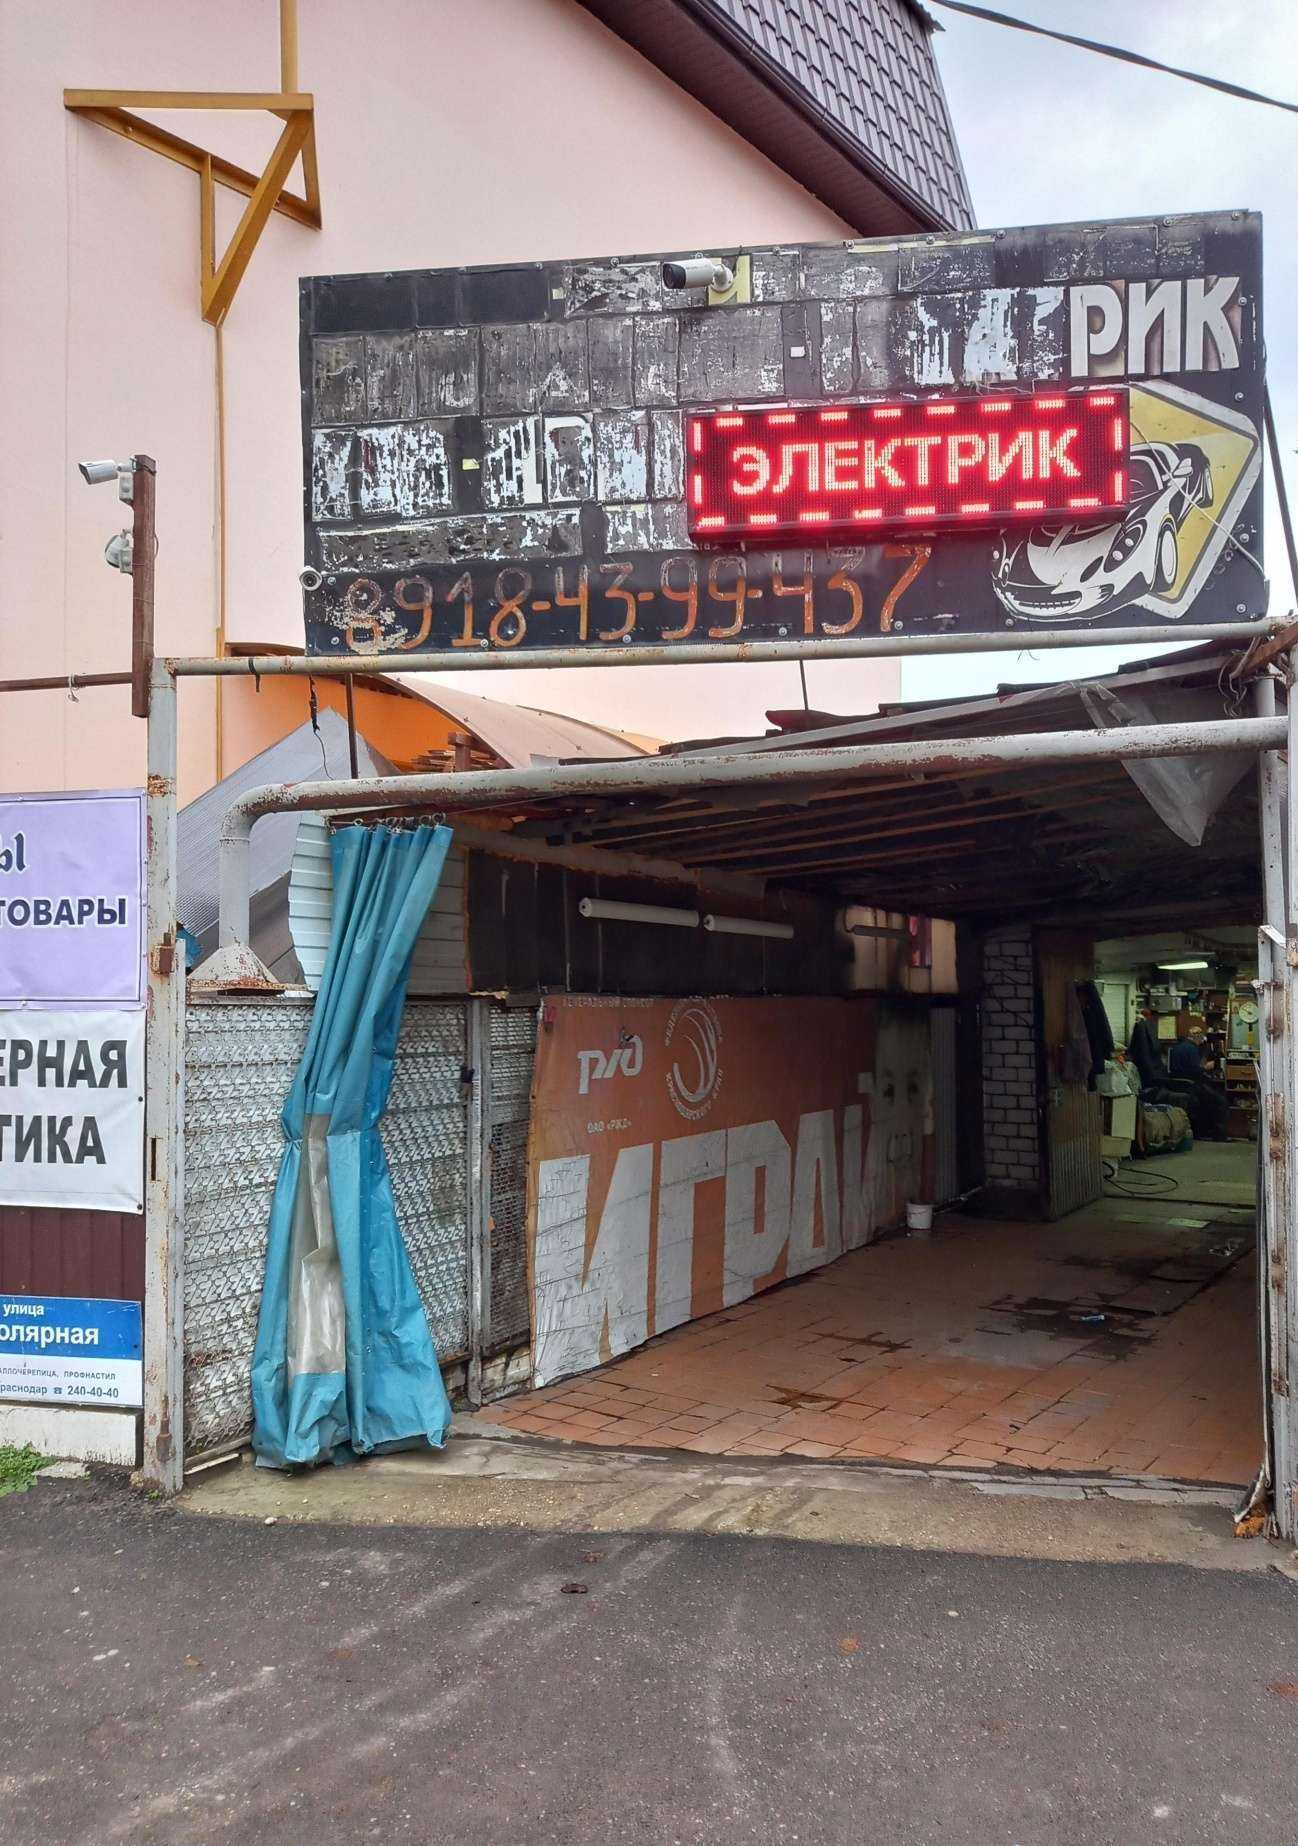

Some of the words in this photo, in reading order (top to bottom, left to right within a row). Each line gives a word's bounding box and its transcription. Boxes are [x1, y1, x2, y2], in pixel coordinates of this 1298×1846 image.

[731, 427, 1082, 495] ЭЛЕКТРИК
[0, 898, 126, 926] ОВАРЫ
[3, 1303, 45, 1317] улица
[64, 1371, 116, 1381] ПРОФНАСТИЛ
[67, 1385, 119, 1399] 240-40-40
